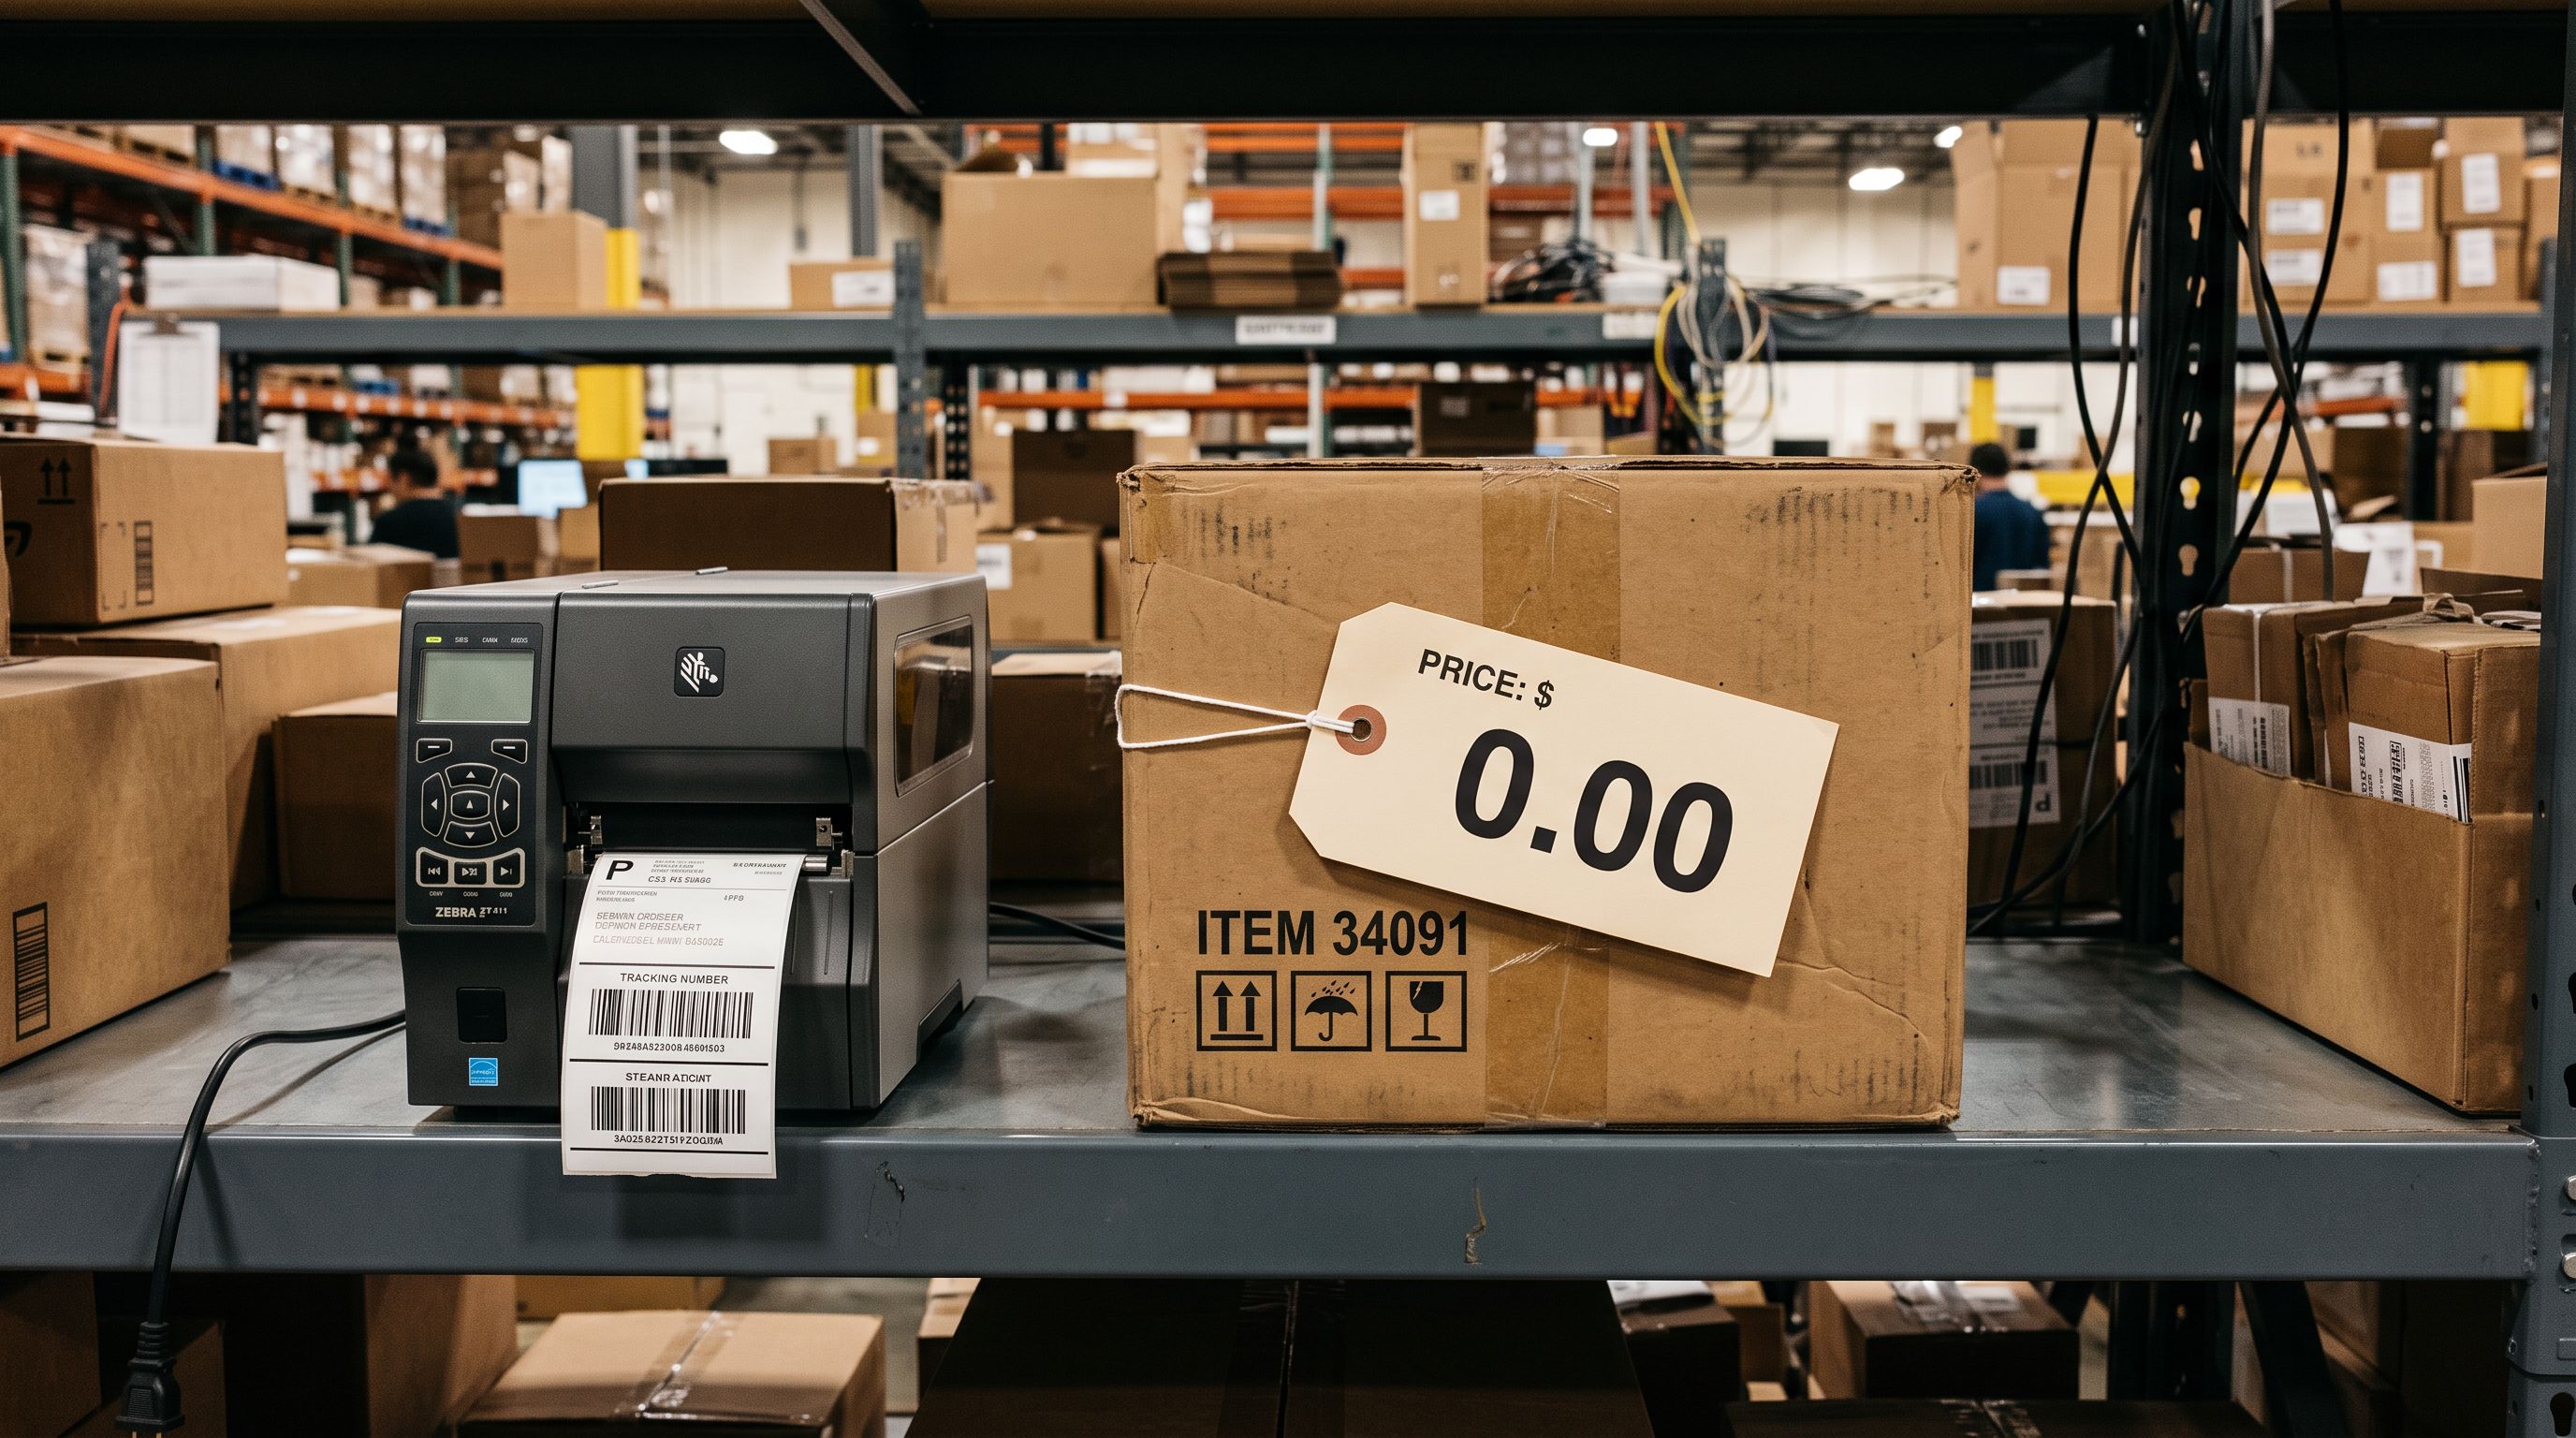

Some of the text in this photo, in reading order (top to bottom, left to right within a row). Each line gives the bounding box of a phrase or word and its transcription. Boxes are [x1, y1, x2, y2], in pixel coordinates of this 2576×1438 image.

[1418, 649, 1556, 711] PRICE: $
[1455, 728, 1734, 894] 0.00
[606, 859, 634, 880] P
[435, 906, 477, 917] ZEBRA
[1198, 910, 1467, 956] ITEM 34091
[621, 973, 729, 984] TRACKING NUMBER
